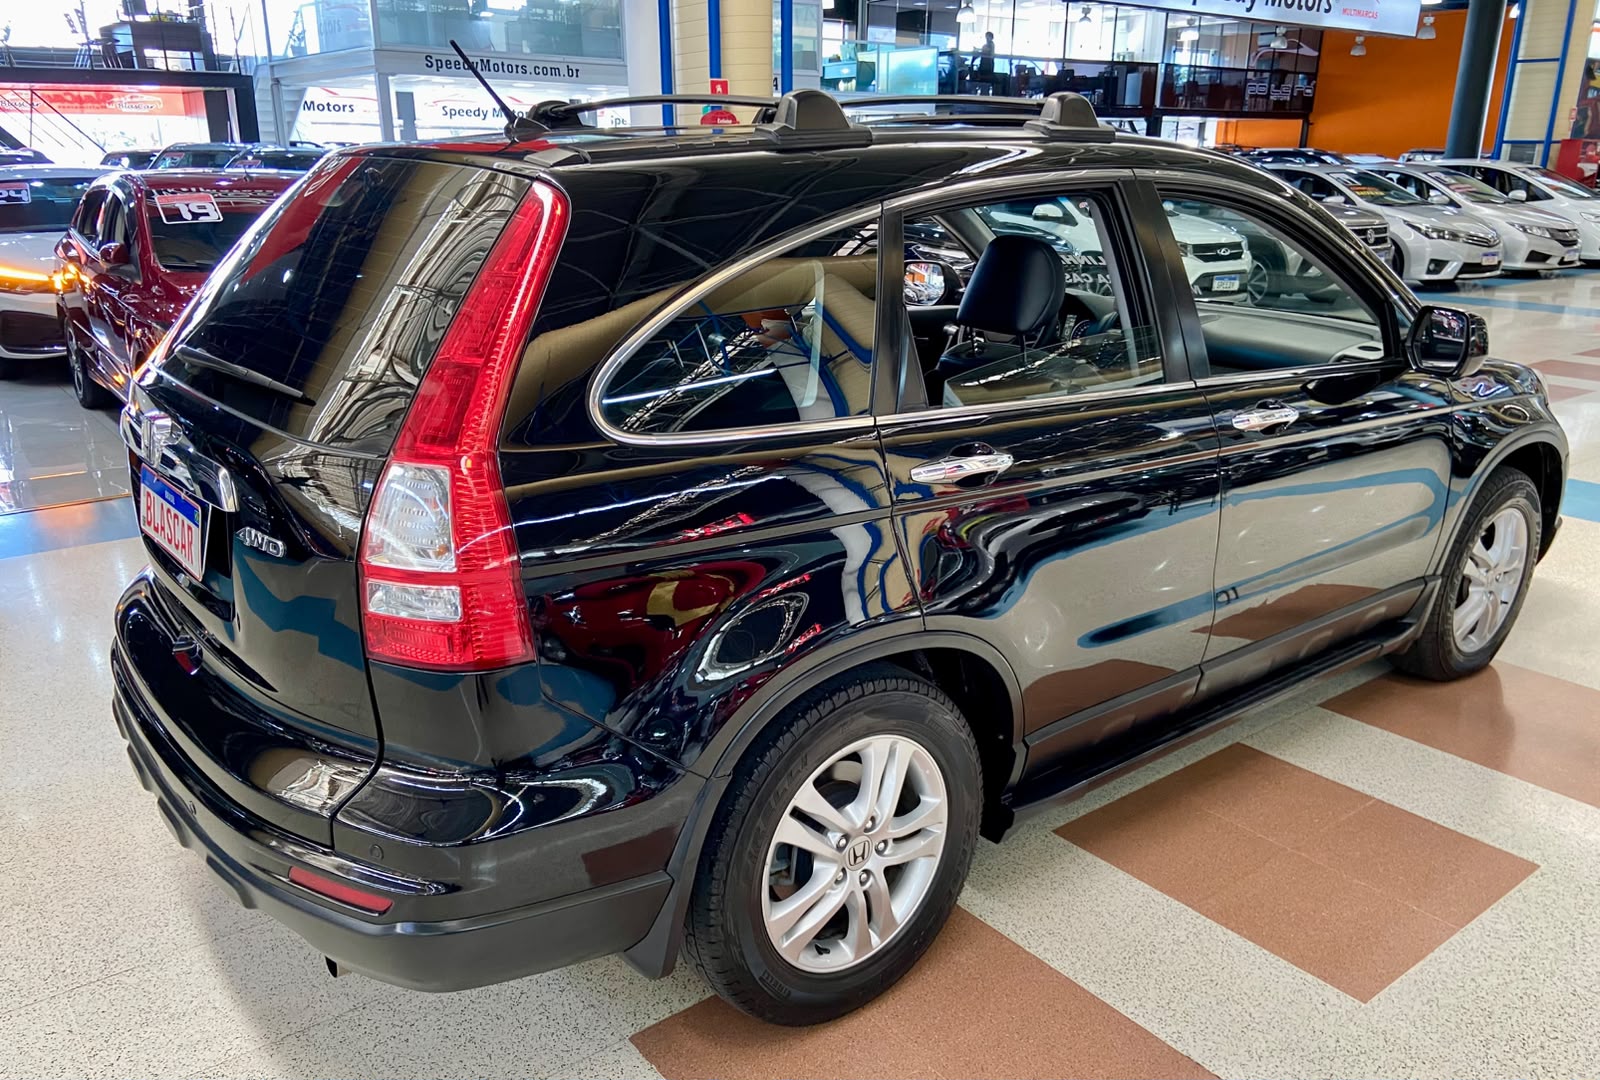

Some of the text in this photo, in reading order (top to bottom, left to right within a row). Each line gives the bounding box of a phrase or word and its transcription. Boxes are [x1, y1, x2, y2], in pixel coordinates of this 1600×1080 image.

[303, 100, 355, 113] Motors
[441, 105, 488, 121] Speedy
[175, 202, 219, 220] 19
[145, 490, 194, 565] BLASCAR
